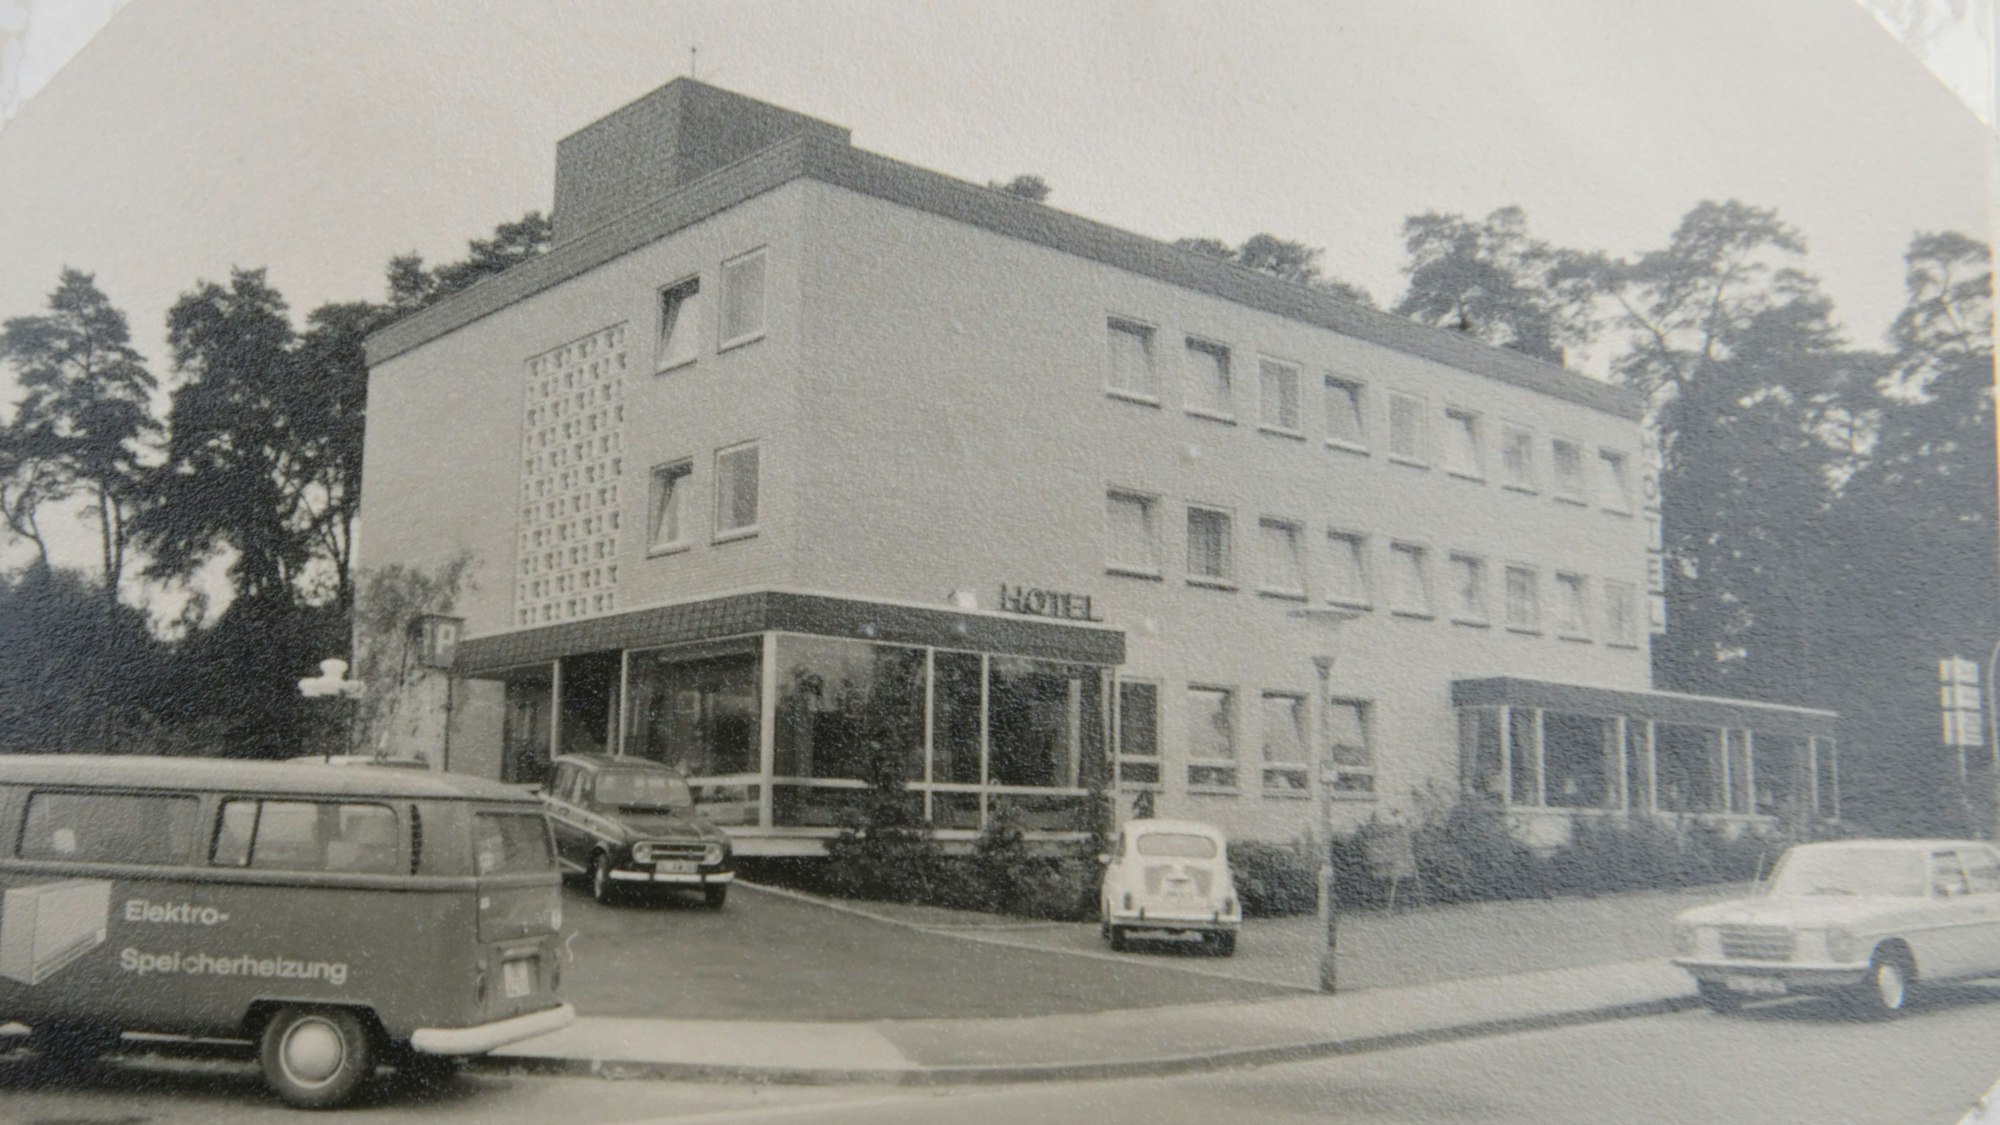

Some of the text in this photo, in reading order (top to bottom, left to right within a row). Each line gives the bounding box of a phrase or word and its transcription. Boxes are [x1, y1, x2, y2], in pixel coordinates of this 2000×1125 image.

[1001, 583, 1103, 622] HOTEL
[124, 900, 230, 925] Elektro-
[120, 948, 347, 984] Speicherheizung
